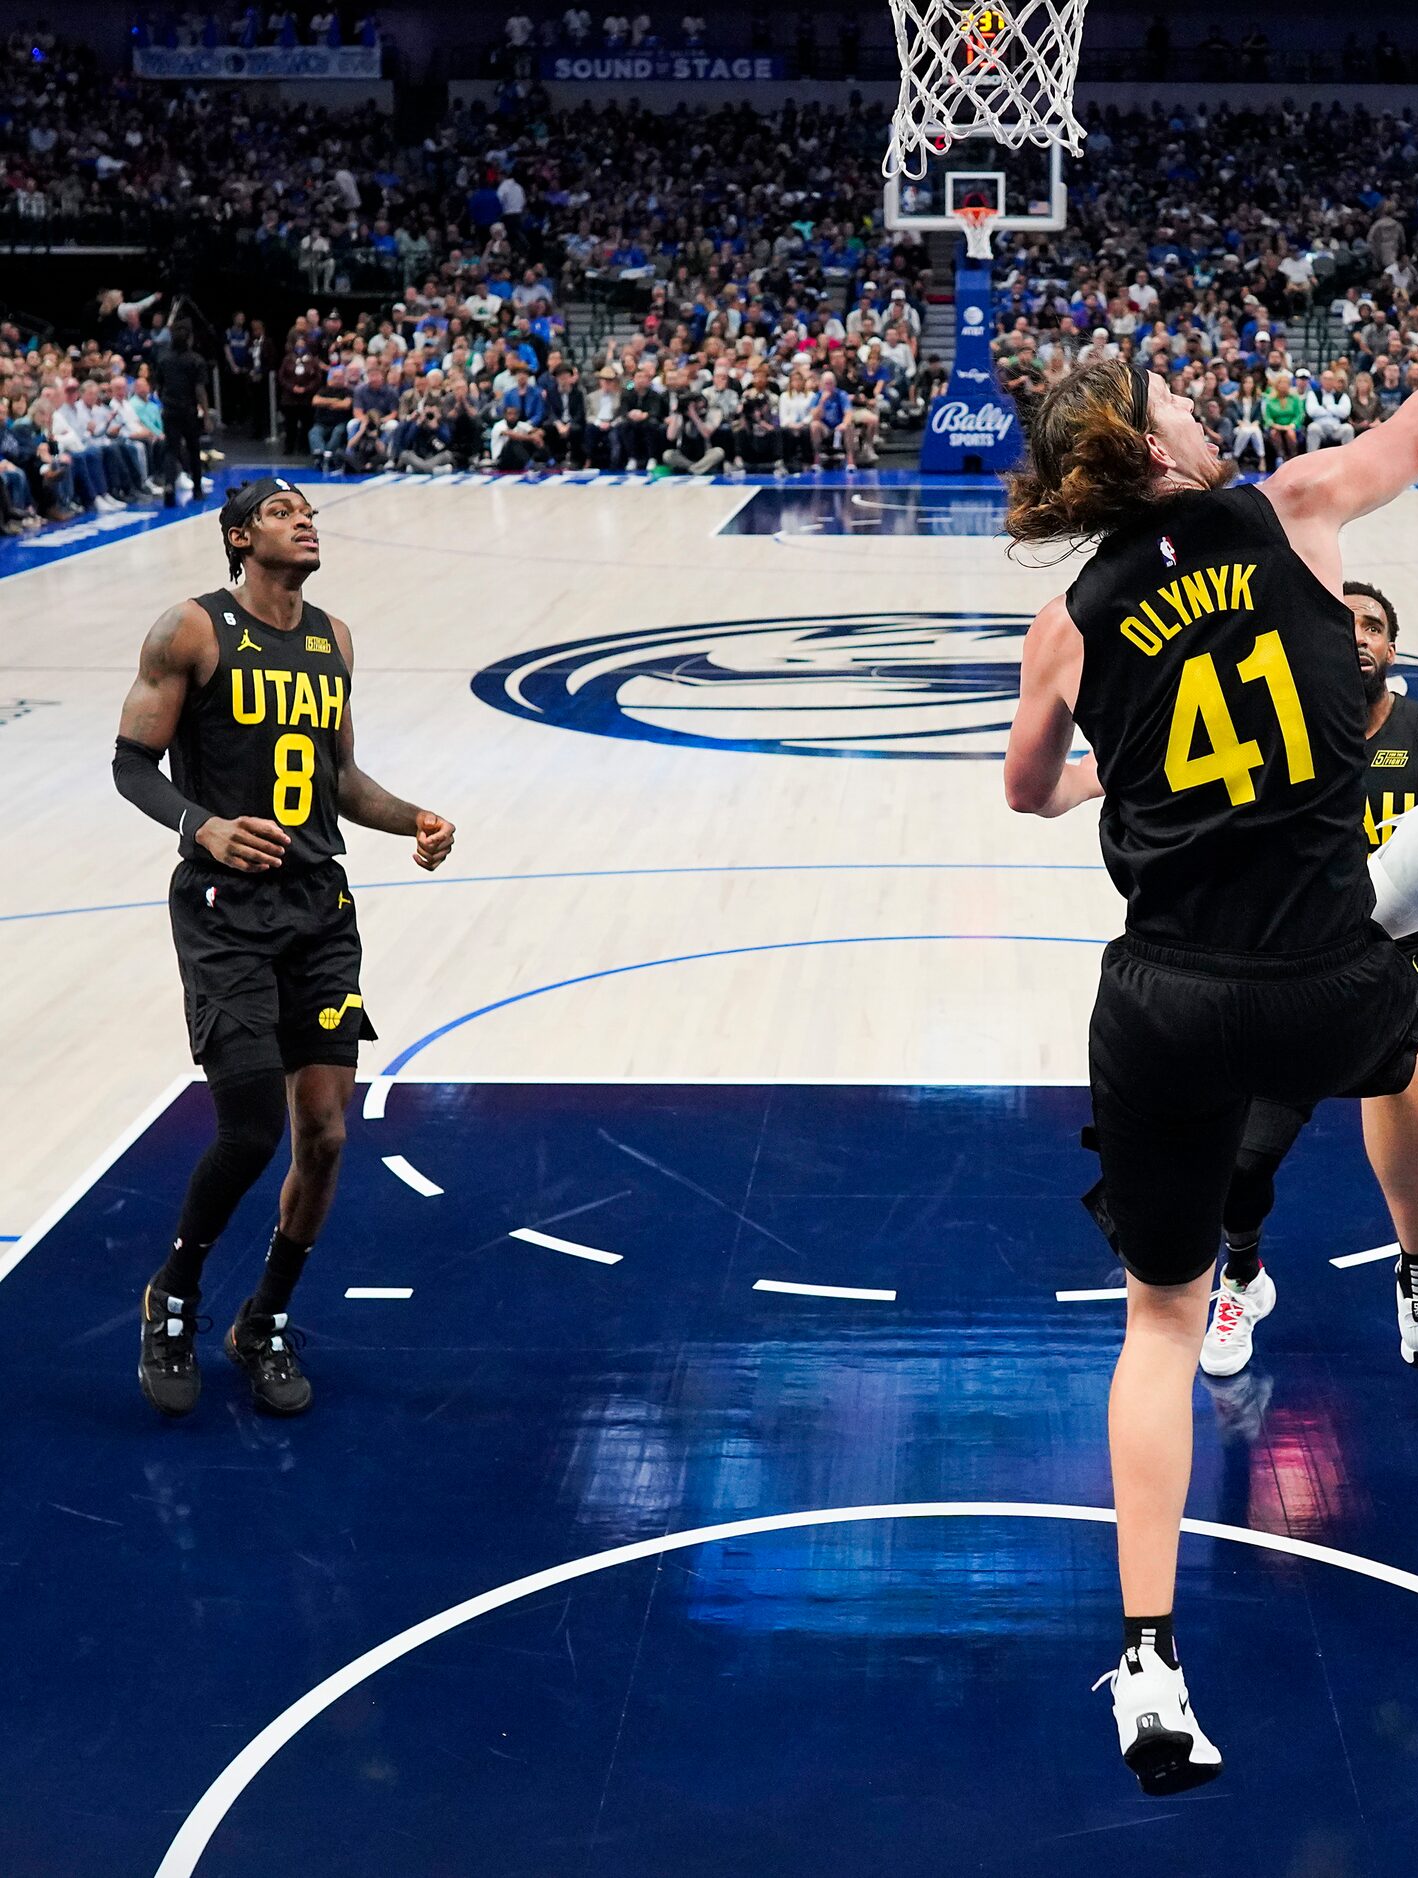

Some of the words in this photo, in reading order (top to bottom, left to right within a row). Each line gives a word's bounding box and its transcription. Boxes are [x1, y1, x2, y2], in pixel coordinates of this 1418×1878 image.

[554, 57, 652, 79] SOUND
[673, 57, 773, 79] STAGE
[931, 401, 1014, 440] Bally
[949, 432, 995, 446] SPORTS
[1120, 563, 1257, 656] OLYNYK
[231, 669, 344, 731] UTAH
[1164, 629, 1315, 806] 41
[1375, 752, 1386, 764] 5
[274, 733, 315, 826] 8
[1141, 1714, 1154, 1728] 07
